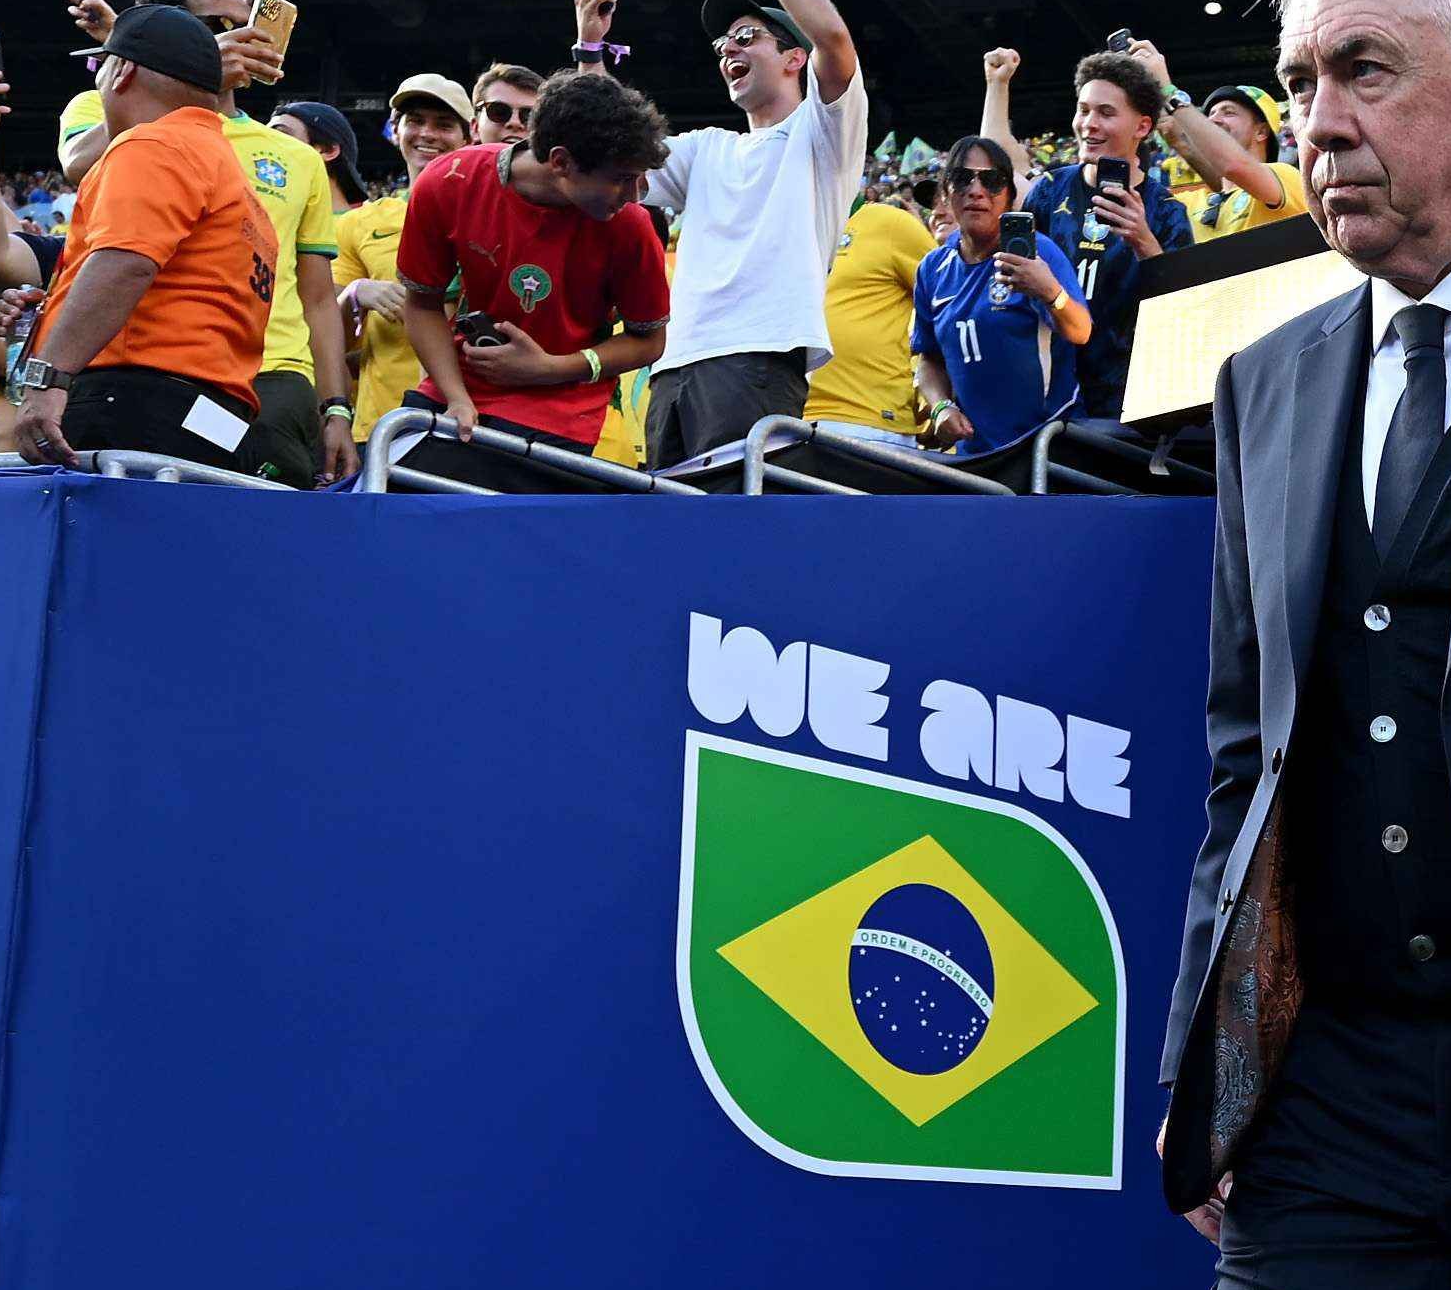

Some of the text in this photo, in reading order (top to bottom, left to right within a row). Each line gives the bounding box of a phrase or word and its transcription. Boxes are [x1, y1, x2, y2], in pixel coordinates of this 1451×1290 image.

[955, 318, 982, 364] 11
[687, 611, 891, 761] WE
[860, 932, 907, 950] ORDEM
[920, 949, 989, 1008] PROGRESSO
